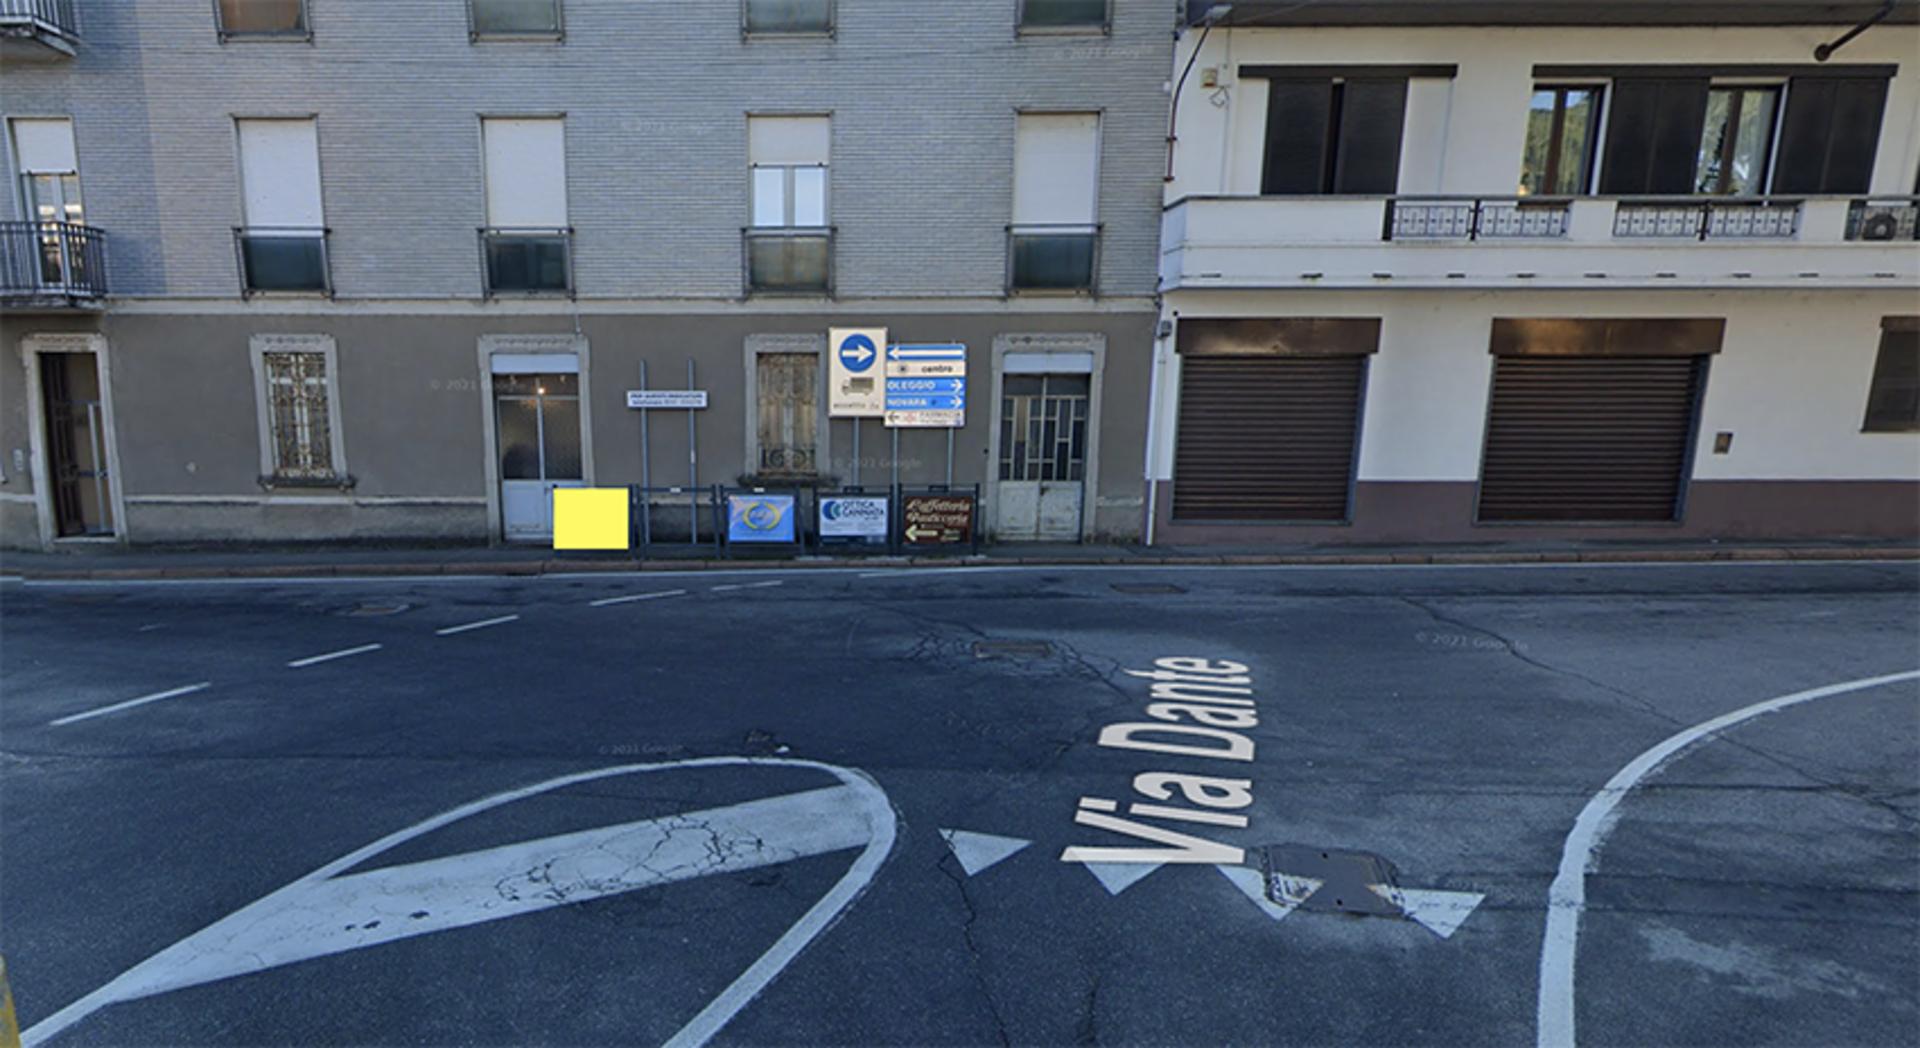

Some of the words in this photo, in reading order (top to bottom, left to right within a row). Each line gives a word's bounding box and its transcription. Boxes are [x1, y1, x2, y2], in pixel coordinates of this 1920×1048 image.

[921, 364, 954, 374] centro
[887, 380, 936, 391] OLEGGIO
[886, 397, 927, 407] NOVARA
